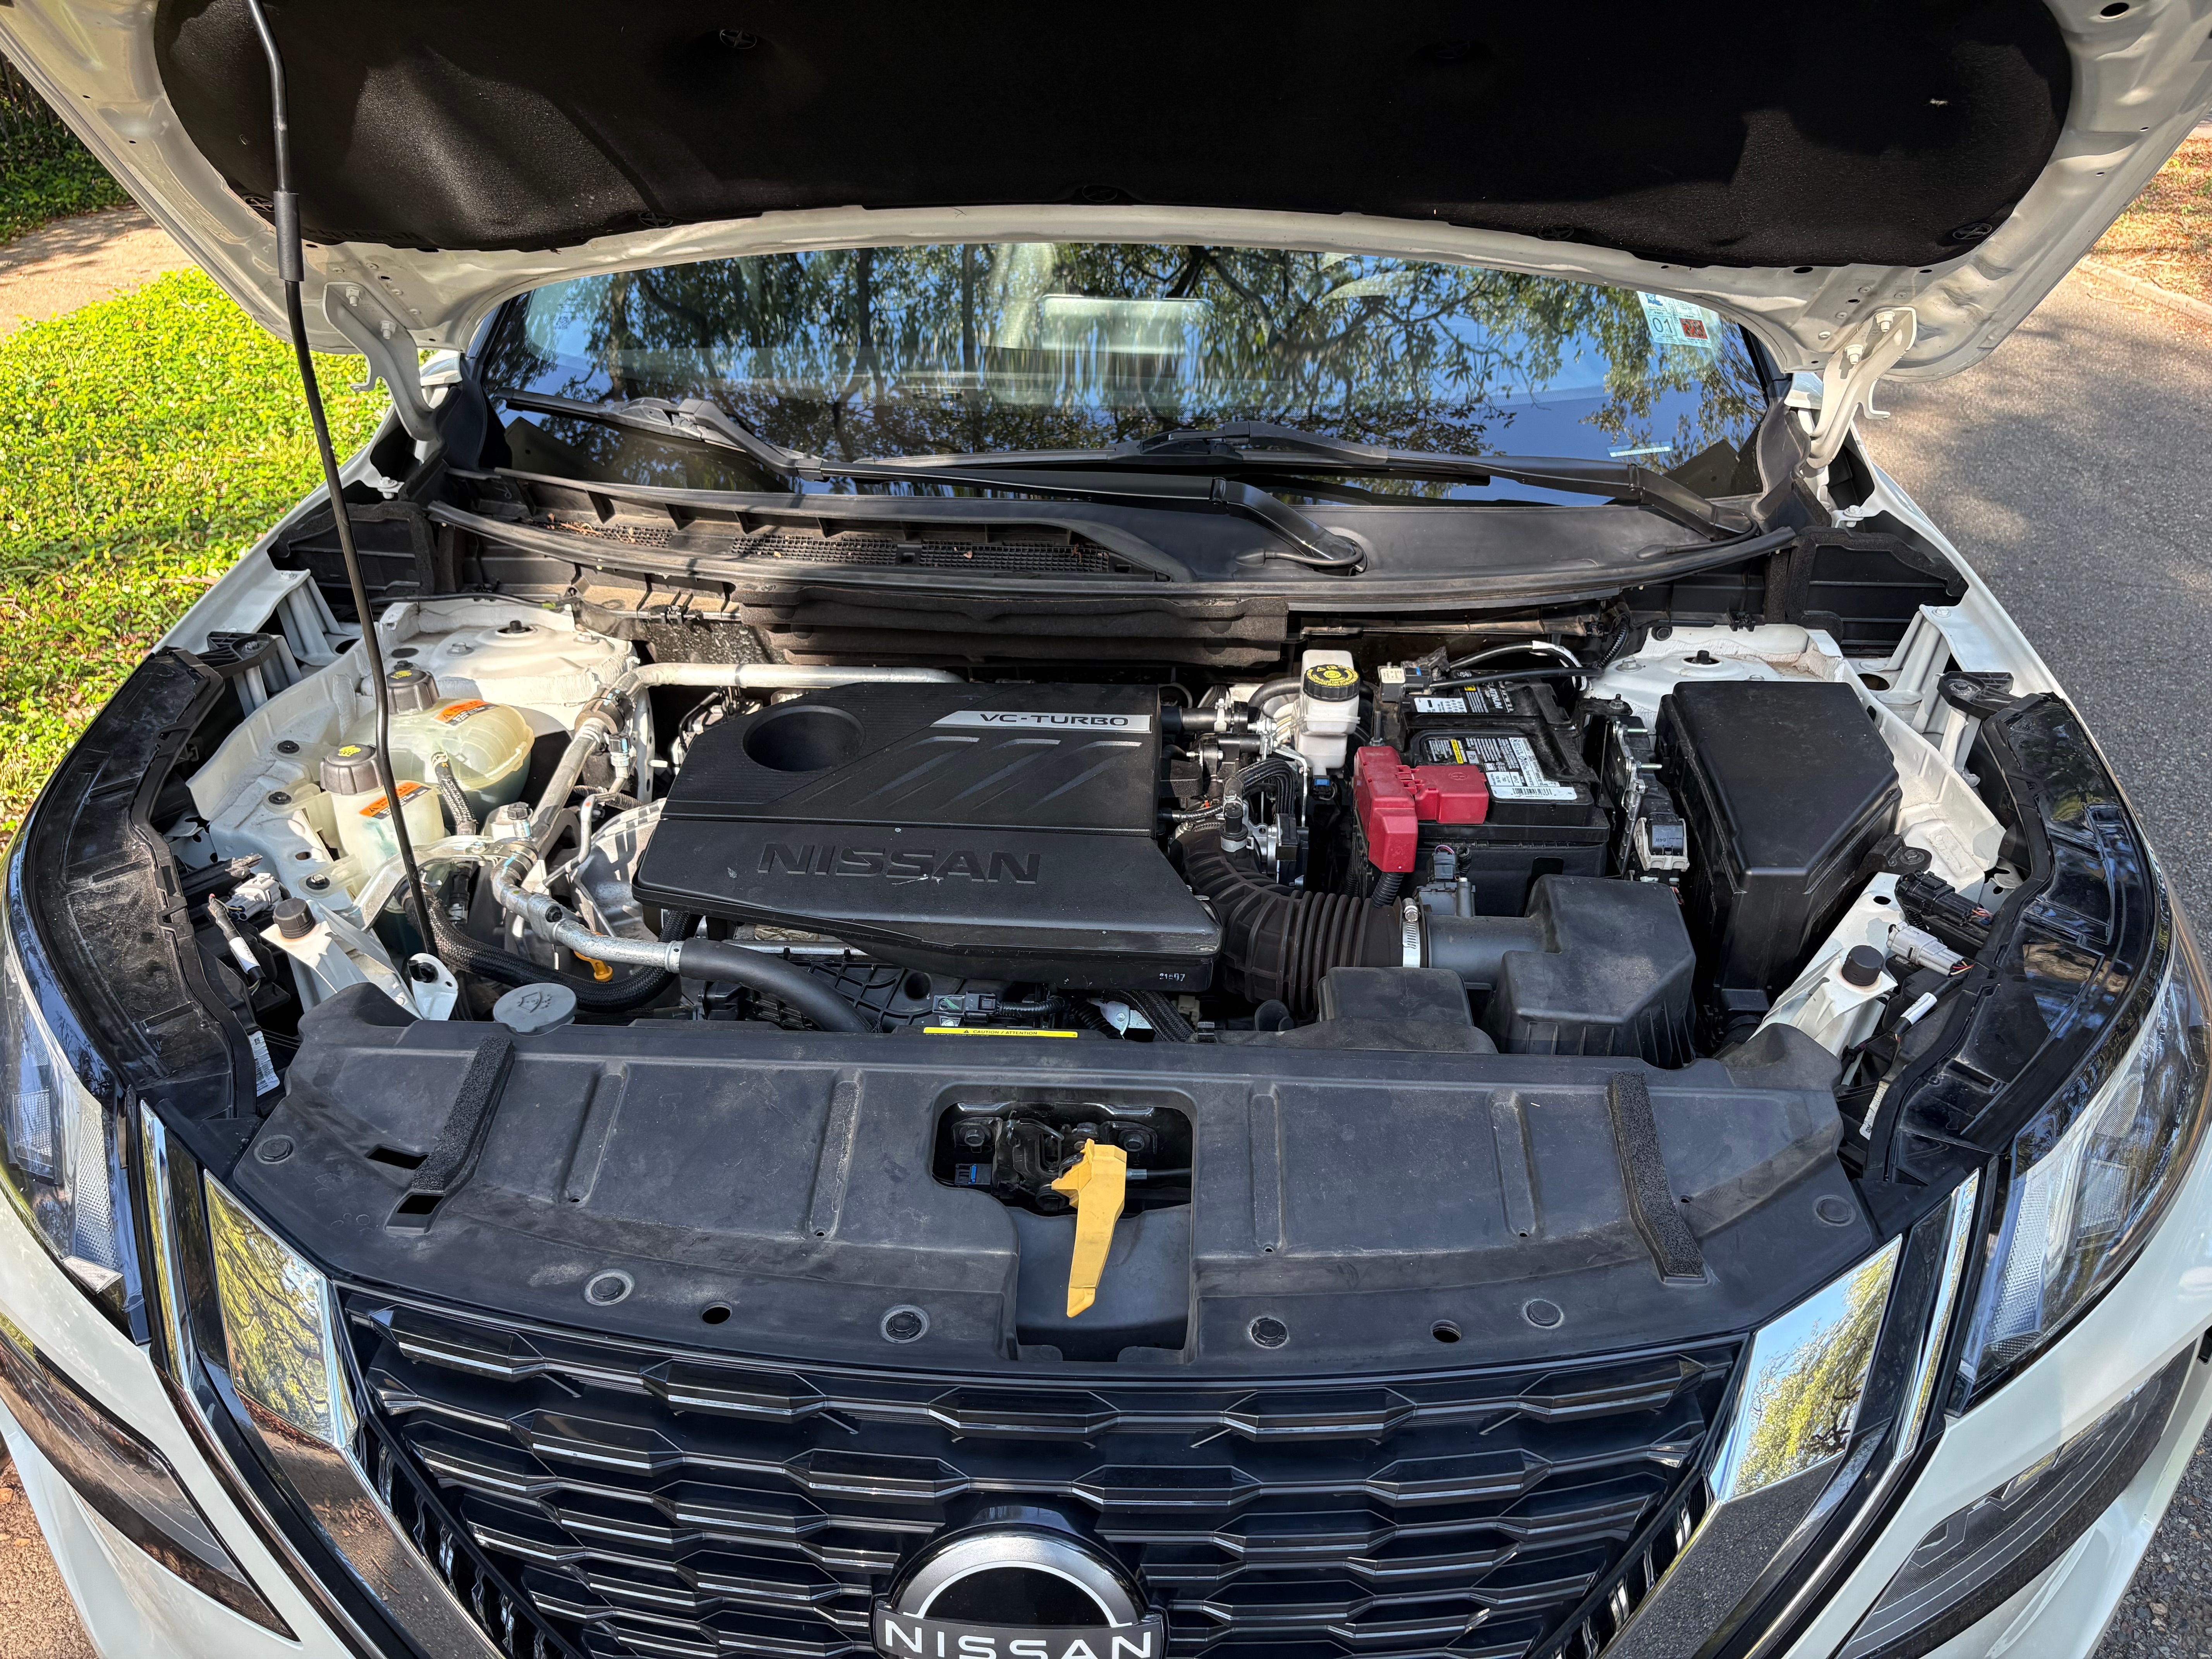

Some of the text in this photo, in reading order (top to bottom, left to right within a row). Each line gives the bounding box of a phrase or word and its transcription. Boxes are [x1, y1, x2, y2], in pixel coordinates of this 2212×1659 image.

[1652, 318, 1673, 333] 01
[979, 713, 1129, 726] VC-TURBO
[757, 843, 1041, 885] NISSAN
[885, 1619, 1151, 1659] NISSAN
